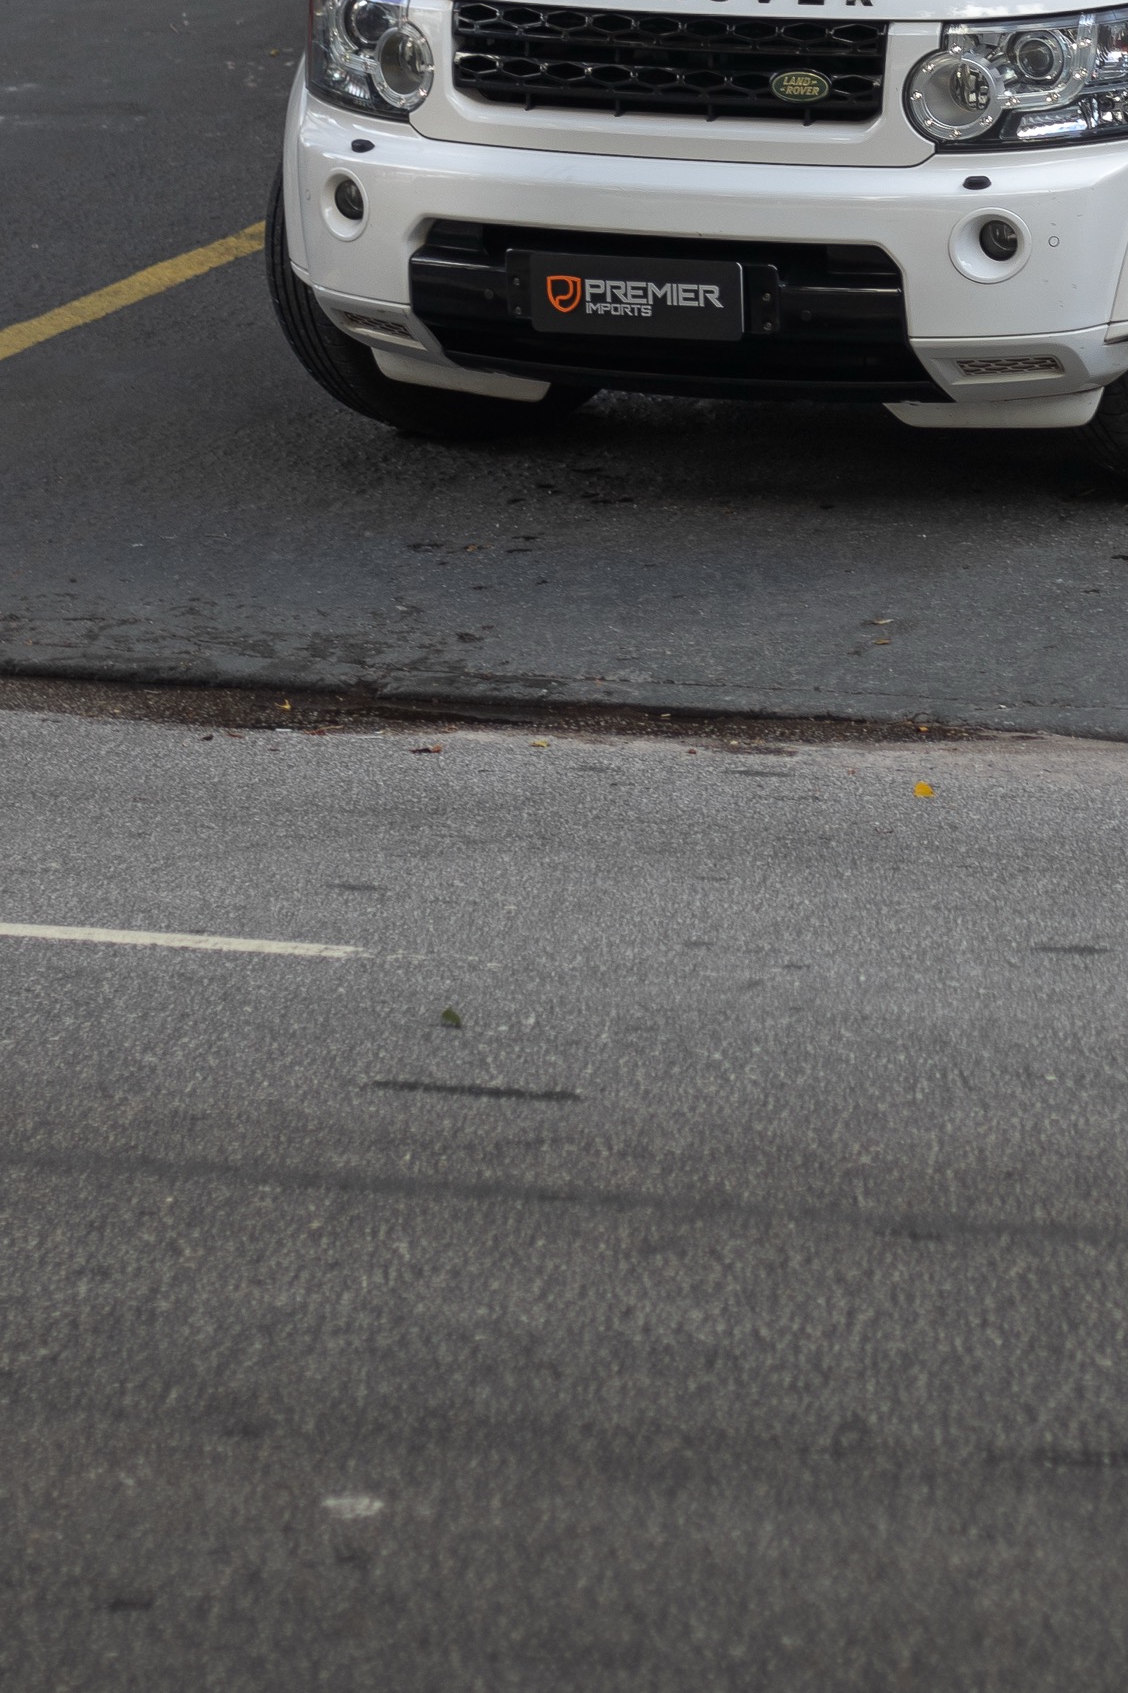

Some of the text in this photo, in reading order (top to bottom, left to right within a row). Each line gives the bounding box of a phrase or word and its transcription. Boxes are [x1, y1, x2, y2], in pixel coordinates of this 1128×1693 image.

[782, 76, 811, 86] LAND
[785, 86, 820, 96] ROVER
[584, 278, 724, 308] PREMIER
[585, 302, 653, 317] IMPORTS
